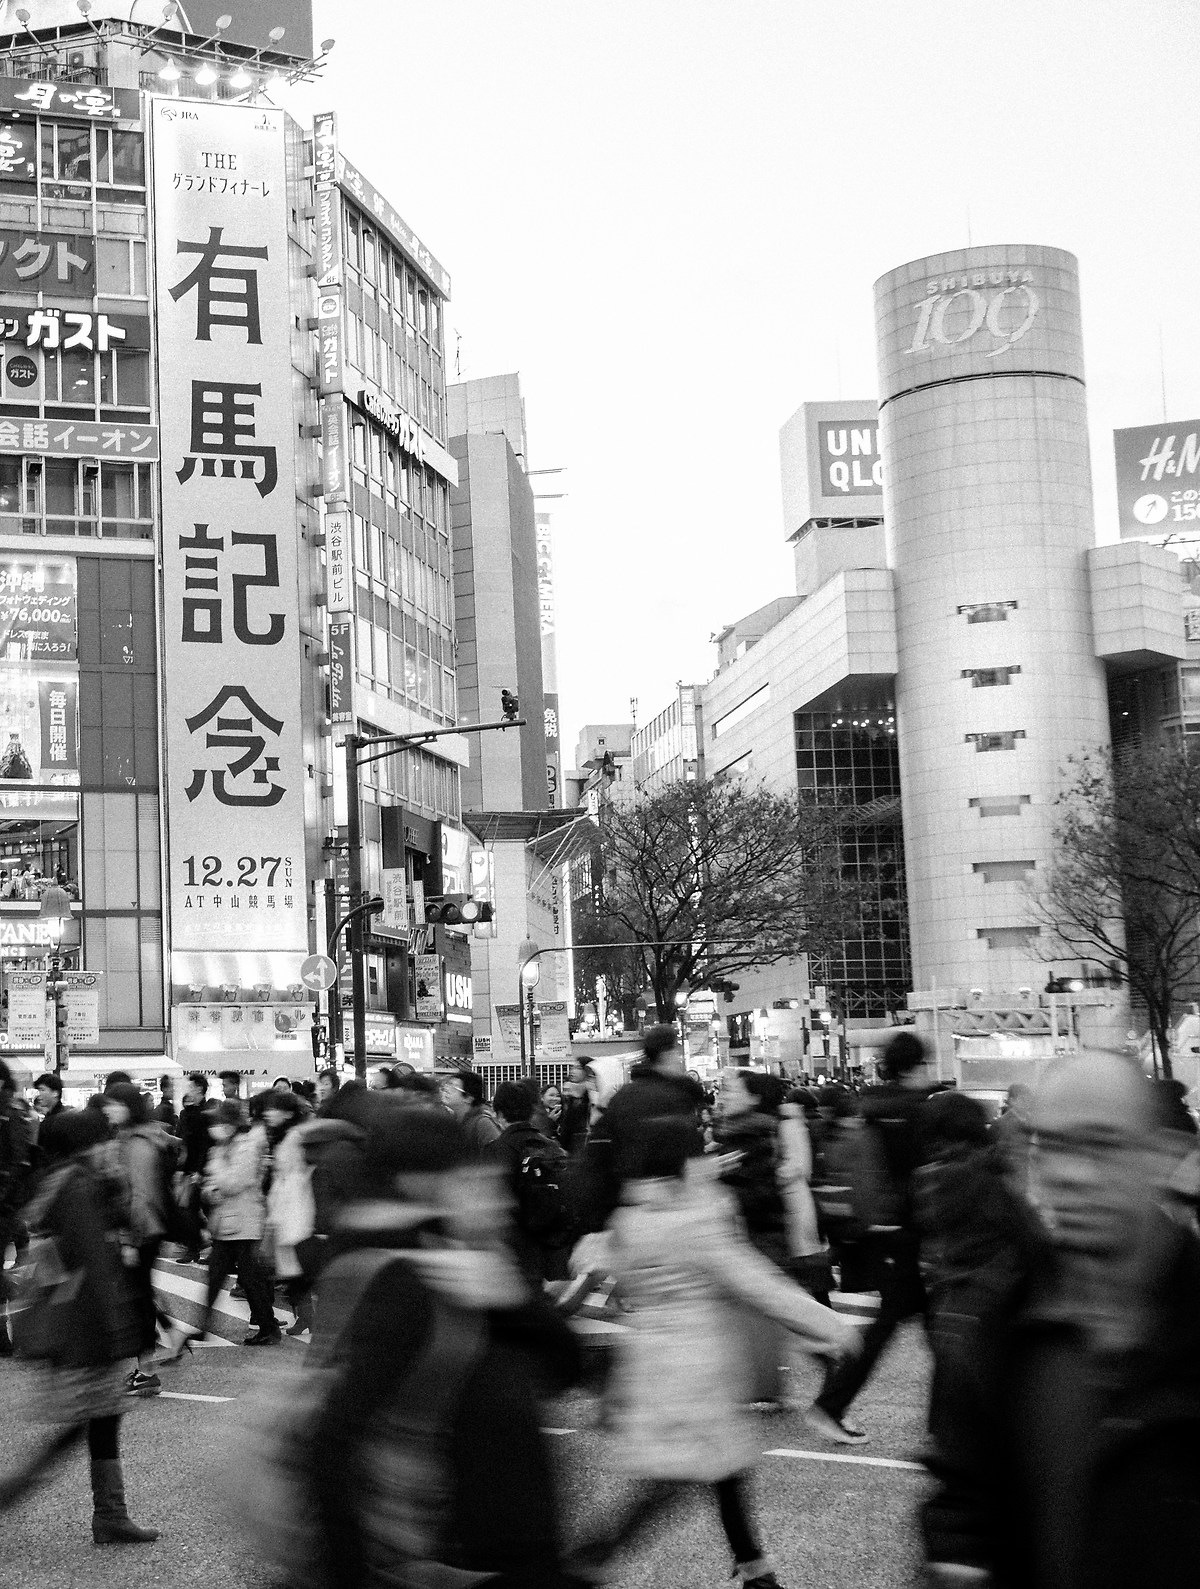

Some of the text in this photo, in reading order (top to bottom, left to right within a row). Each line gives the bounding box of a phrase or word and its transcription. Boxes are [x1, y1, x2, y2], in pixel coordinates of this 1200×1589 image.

[202, 151, 237, 171] THE
[173, 172, 270, 197] グランドフィナーレ
[926, 269, 1035, 295] SHIBUYA
[26, 309, 127, 351] ガスト
[903, 285, 1040, 358] 109
[10, 369, 35, 380] ガスト
[1171, 489, 1200, 502] この
[168, 226, 287, 807] 有馬記念
[330, 522, 344, 603] 渋谷駅前ビル
[331, 624, 349, 635] 5F
[331, 641, 344, 708] La Fiesta
[48, 689, 68, 762] 毎日開催
[543, 707, 557, 738] 免税
[182, 855, 293, 888] 12.27 SUN
[185, 894, 294, 909] AT 中山競馬場
[446, 973, 473, 1009] USH
